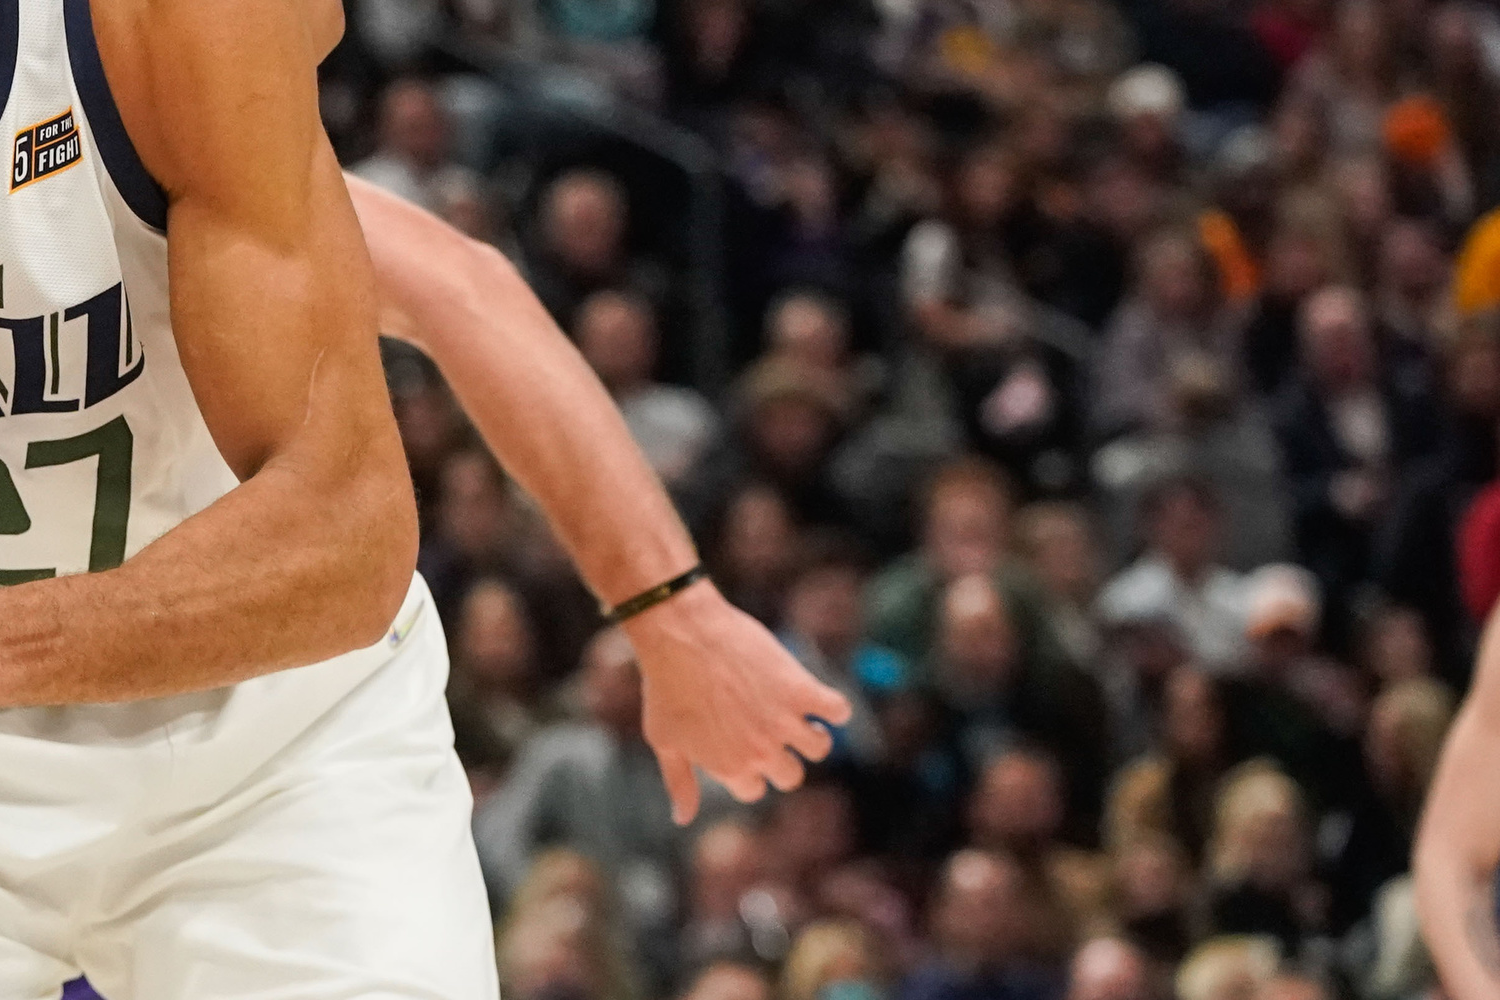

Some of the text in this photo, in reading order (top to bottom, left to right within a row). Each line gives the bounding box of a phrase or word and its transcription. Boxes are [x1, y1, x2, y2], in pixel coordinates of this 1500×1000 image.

[40, 123, 59, 141] FOR
[14, 136, 28, 182] 5
[38, 135, 79, 172] FIGHT
